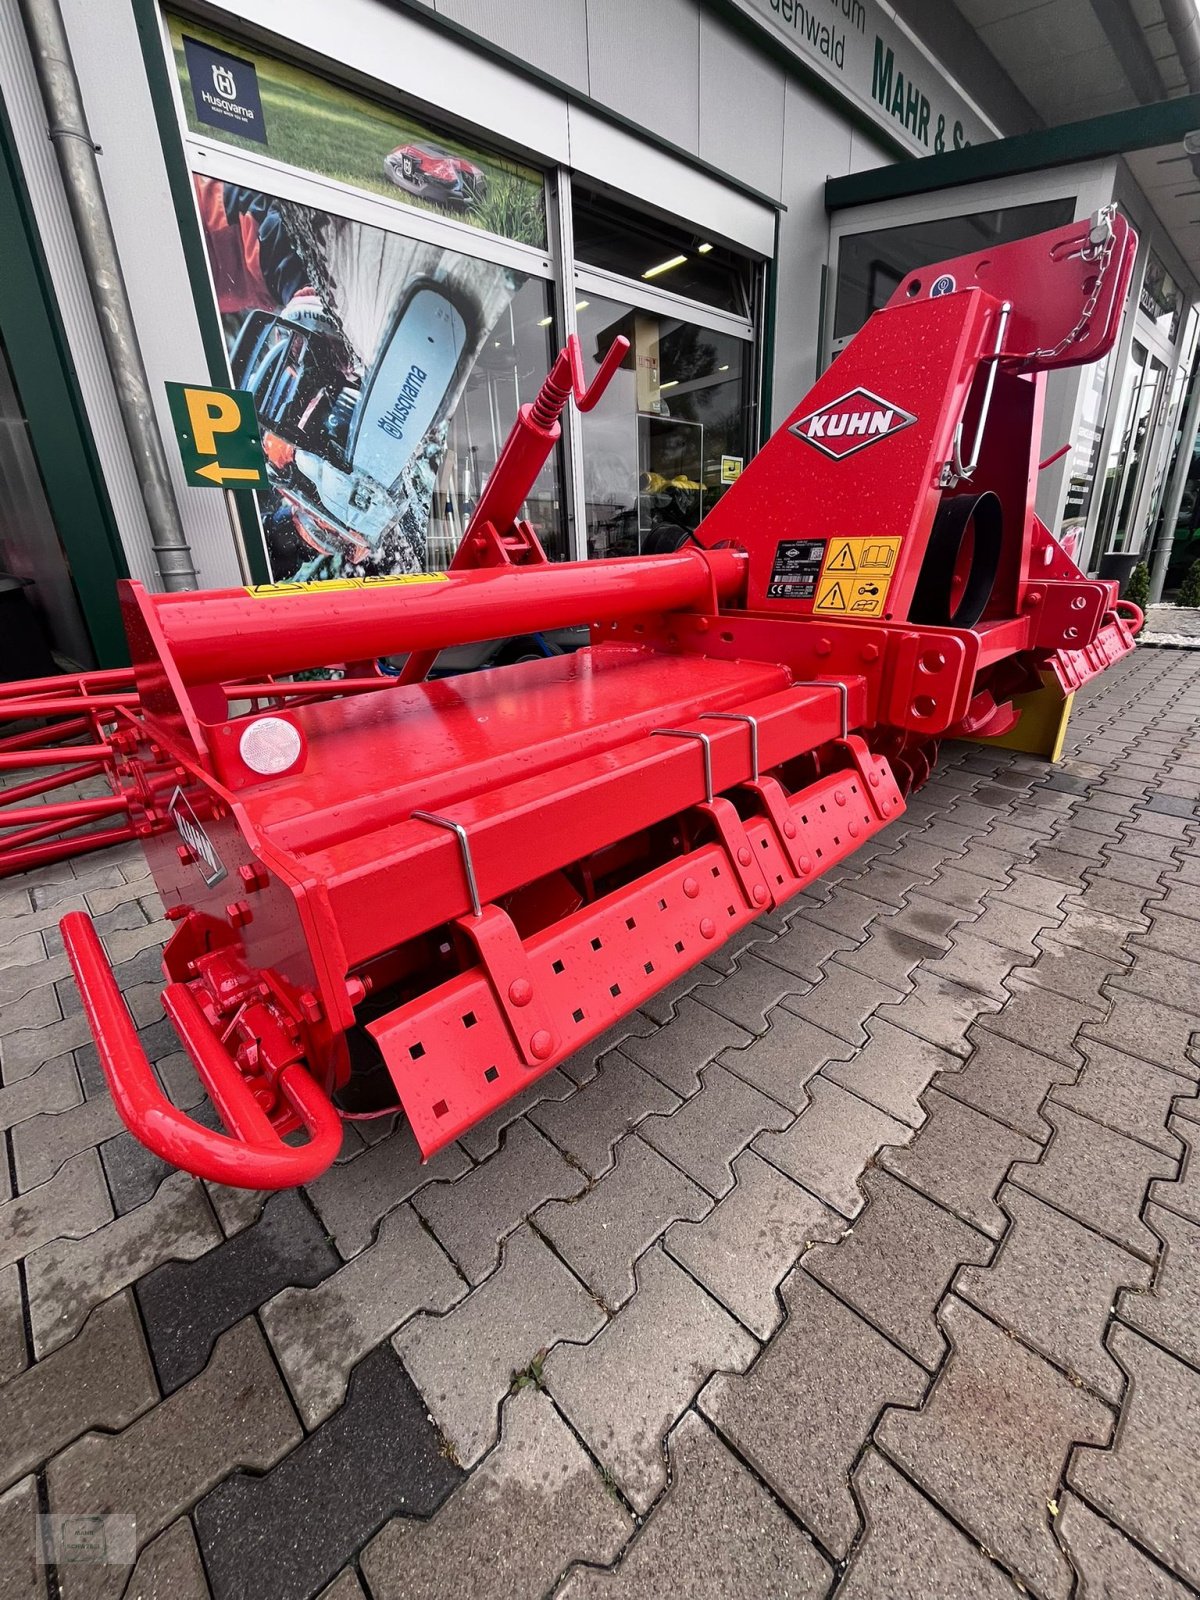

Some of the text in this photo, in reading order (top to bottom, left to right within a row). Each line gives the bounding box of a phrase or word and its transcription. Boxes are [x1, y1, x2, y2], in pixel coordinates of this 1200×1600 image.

[831, 0, 866, 35] um
[201, 90, 254, 119] Husqvarna
[871, 34, 931, 147] MAHR
[934, 113, 946, 155] &
[184, 388, 242, 455] P
[386, 364, 428, 430] Husqvarna
[807, 410, 894, 437] KUHN
[173, 807, 218, 873] KUHN
